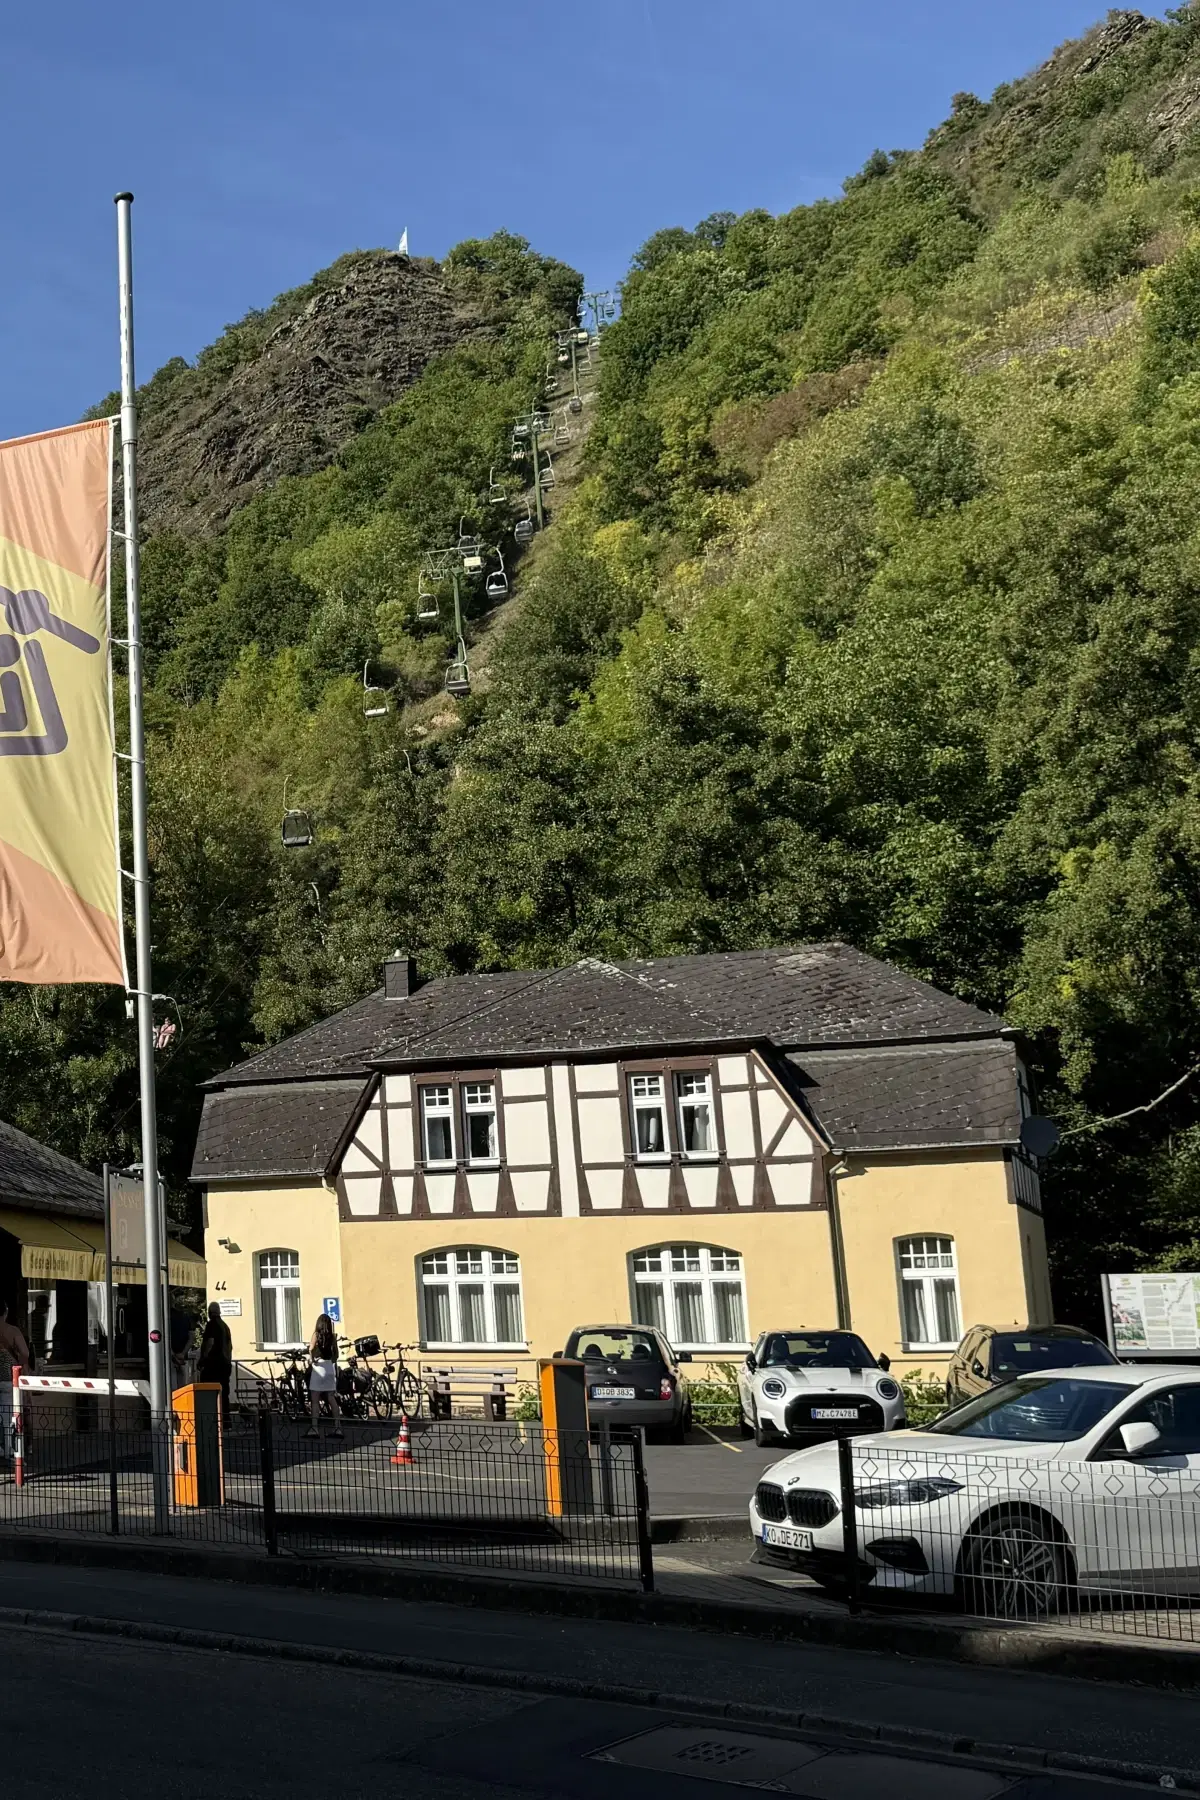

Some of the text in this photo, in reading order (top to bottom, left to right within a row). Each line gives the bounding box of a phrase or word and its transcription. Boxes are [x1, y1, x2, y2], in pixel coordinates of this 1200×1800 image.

[215, 1281, 227, 1291] 44
[327, 1299, 337, 1312] P
[781, 1531, 792, 1546] DE
[793, 1532, 810, 1549] 271
